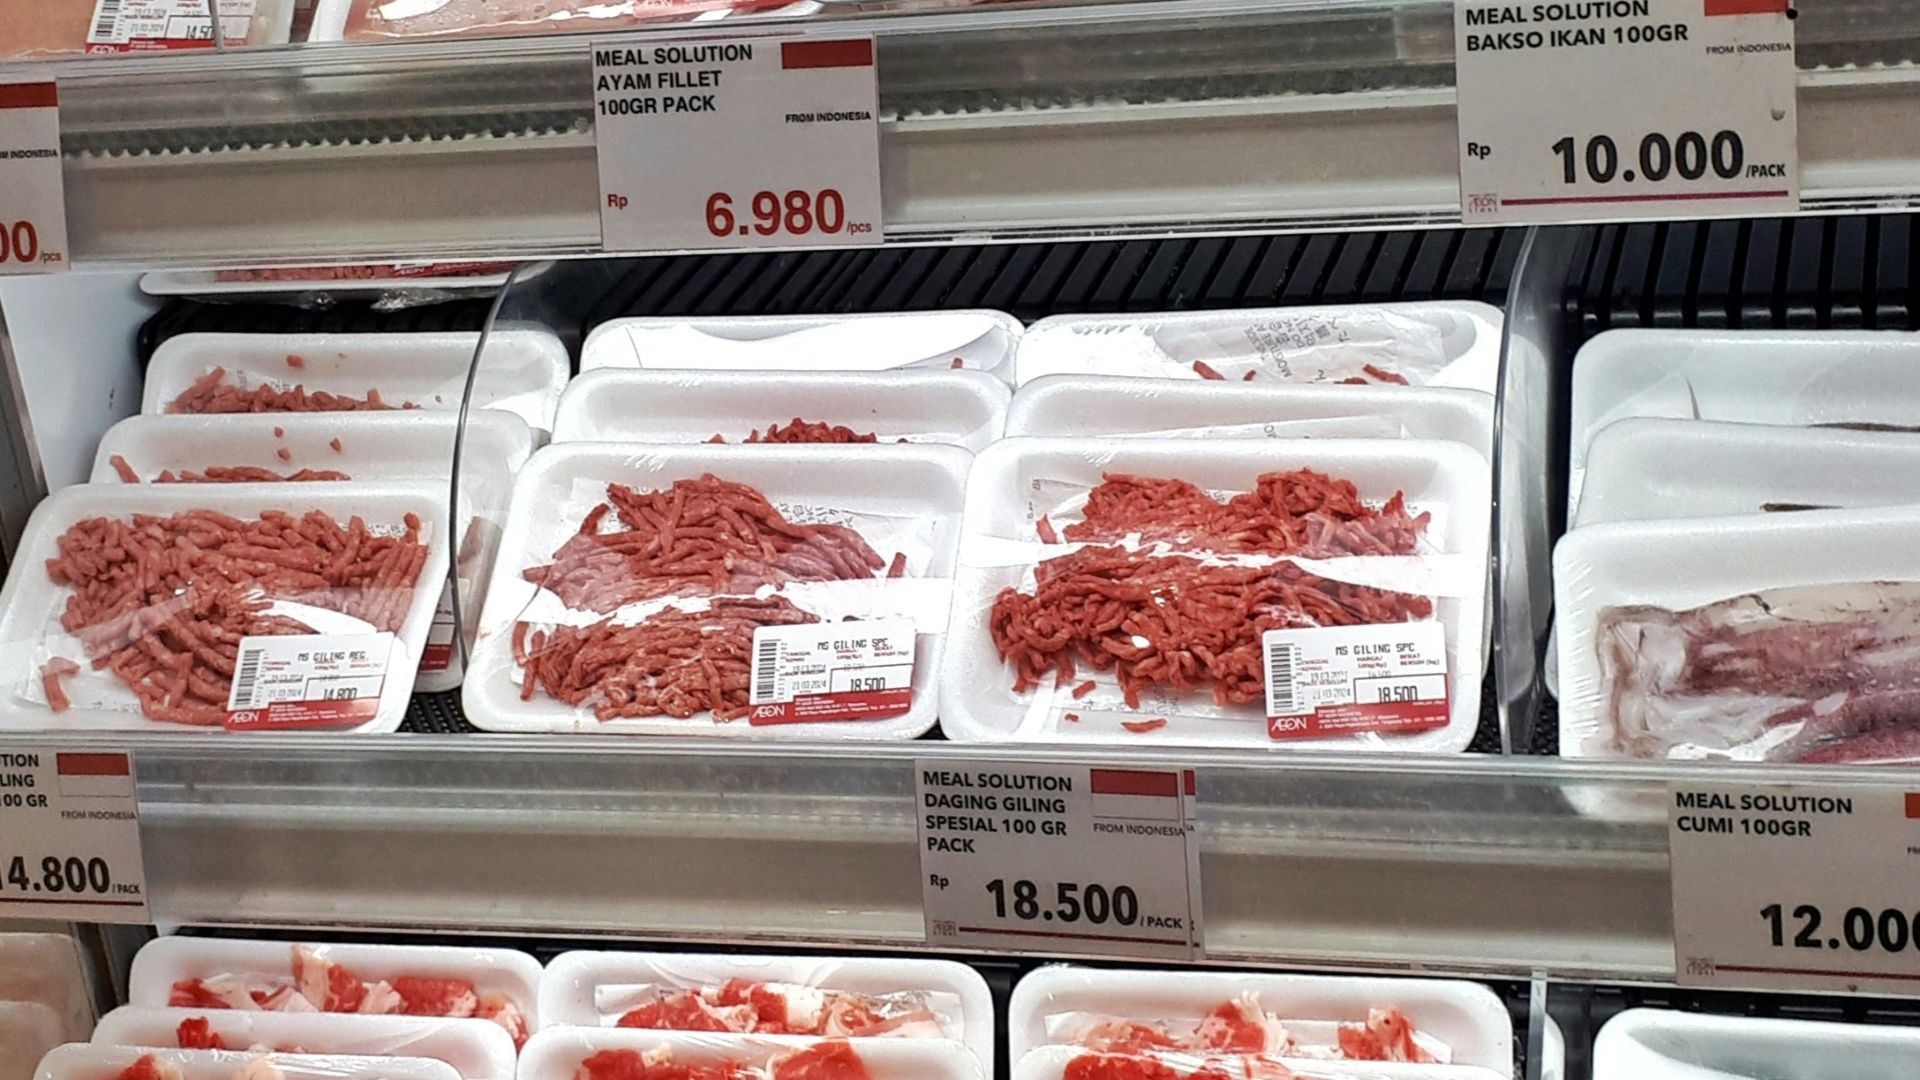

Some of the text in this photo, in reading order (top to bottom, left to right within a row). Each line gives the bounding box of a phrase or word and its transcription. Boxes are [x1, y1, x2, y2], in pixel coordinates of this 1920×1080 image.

[1466, 0, 1649, 25] MEAL SOLUTION
[1467, 24, 1688, 51] BAKSO IKAN 100GR
[596, 44, 753, 66] MEAL SOLUTION
[1706, 43, 1792, 54] FROM INDONESIA
[597, 70, 722, 91] AYAM FILLET
[599, 95, 716, 115] 100GR PACK
[785, 112, 871, 123] FROM INDONESIA
[10, 149, 58, 158] INDONESIA
[1467, 142, 1491, 160] Rp
[1552, 130, 1744, 184] 10.000
[607, 194, 628, 209] Rp
[706, 189, 872, 237] 6.980 /pcs
[40, 251, 62, 263] /pcs
[817, 641, 829, 651] MS
[833, 640, 867, 650] GILING
[1335, 642, 1415, 656] MS GILING SPC
[298, 652, 309, 661] MS
[313, 651, 345, 660] GILING
[923, 771, 1072, 791] MEAL SOLUTION
[26, 793, 48, 808] GR
[925, 794, 1066, 813] DAGING GILING
[1676, 792, 1852, 813] MEAL SOLUTION
[61, 811, 86, 819] FROM
[926, 815, 1067, 835] SPESIAL 100 GR
[1093, 823, 1125, 832] FROM
[1126, 825, 1185, 836] INDONESIA
[1677, 816, 1811, 836] CUMI 100GR
[927, 837, 975, 853] PACK
[0, 856, 110, 894] 4.800
[930, 874, 949, 889] Rp
[986, 879, 1138, 925] 18.500
